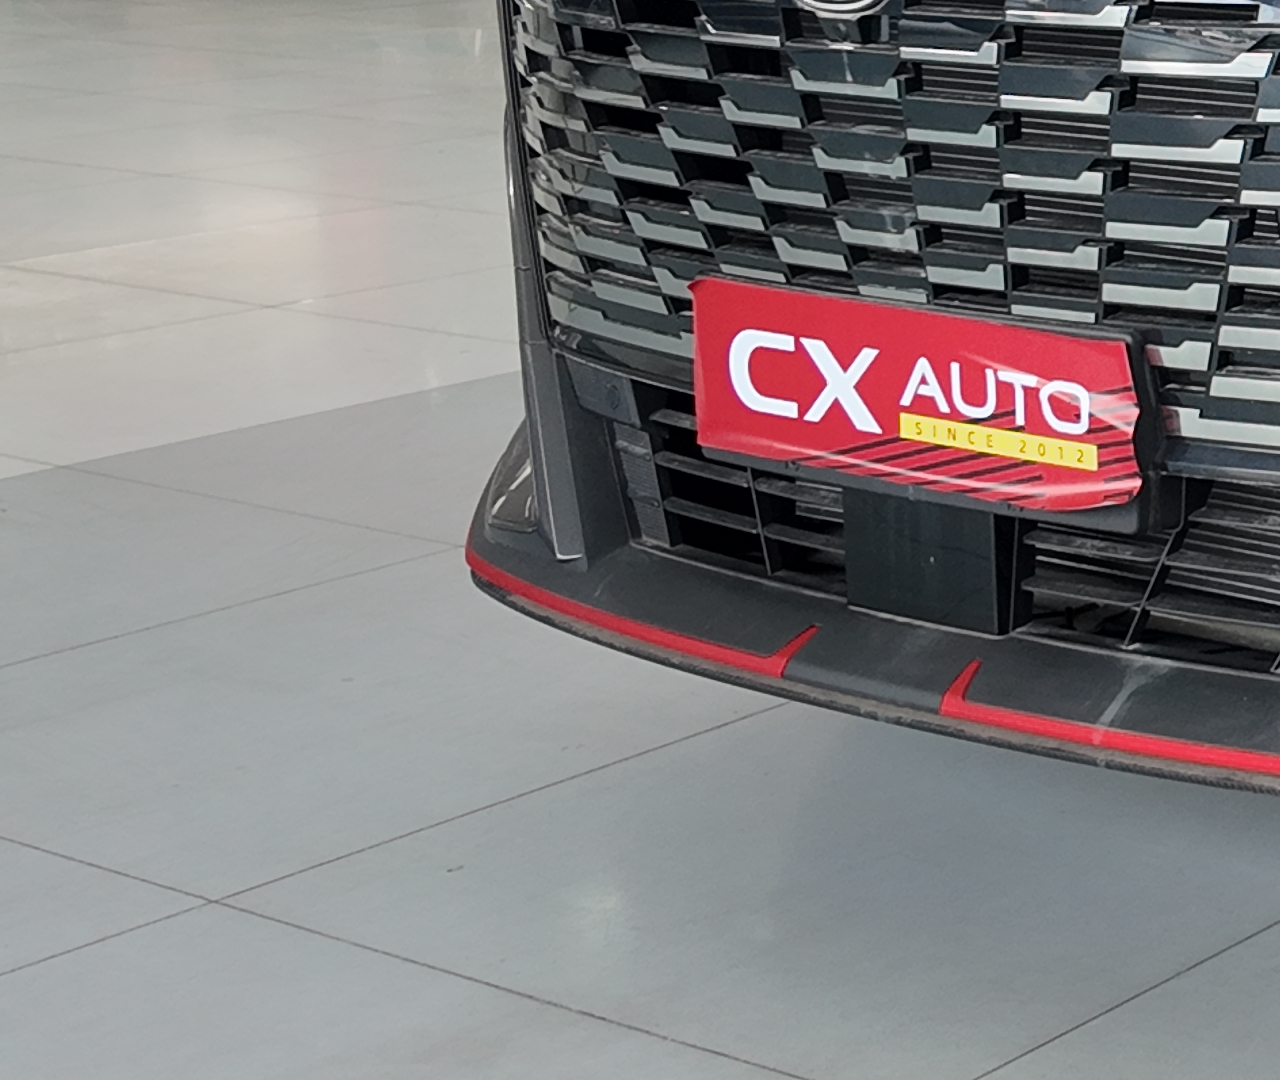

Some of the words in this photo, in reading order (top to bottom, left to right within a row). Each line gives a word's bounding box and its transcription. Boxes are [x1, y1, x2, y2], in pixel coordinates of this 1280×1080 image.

[728, 328, 883, 435] CX
[900, 356, 1091, 435] AUTO
[914, 420, 997, 451] SINCE
[1018, 438, 1088, 465] 2012
